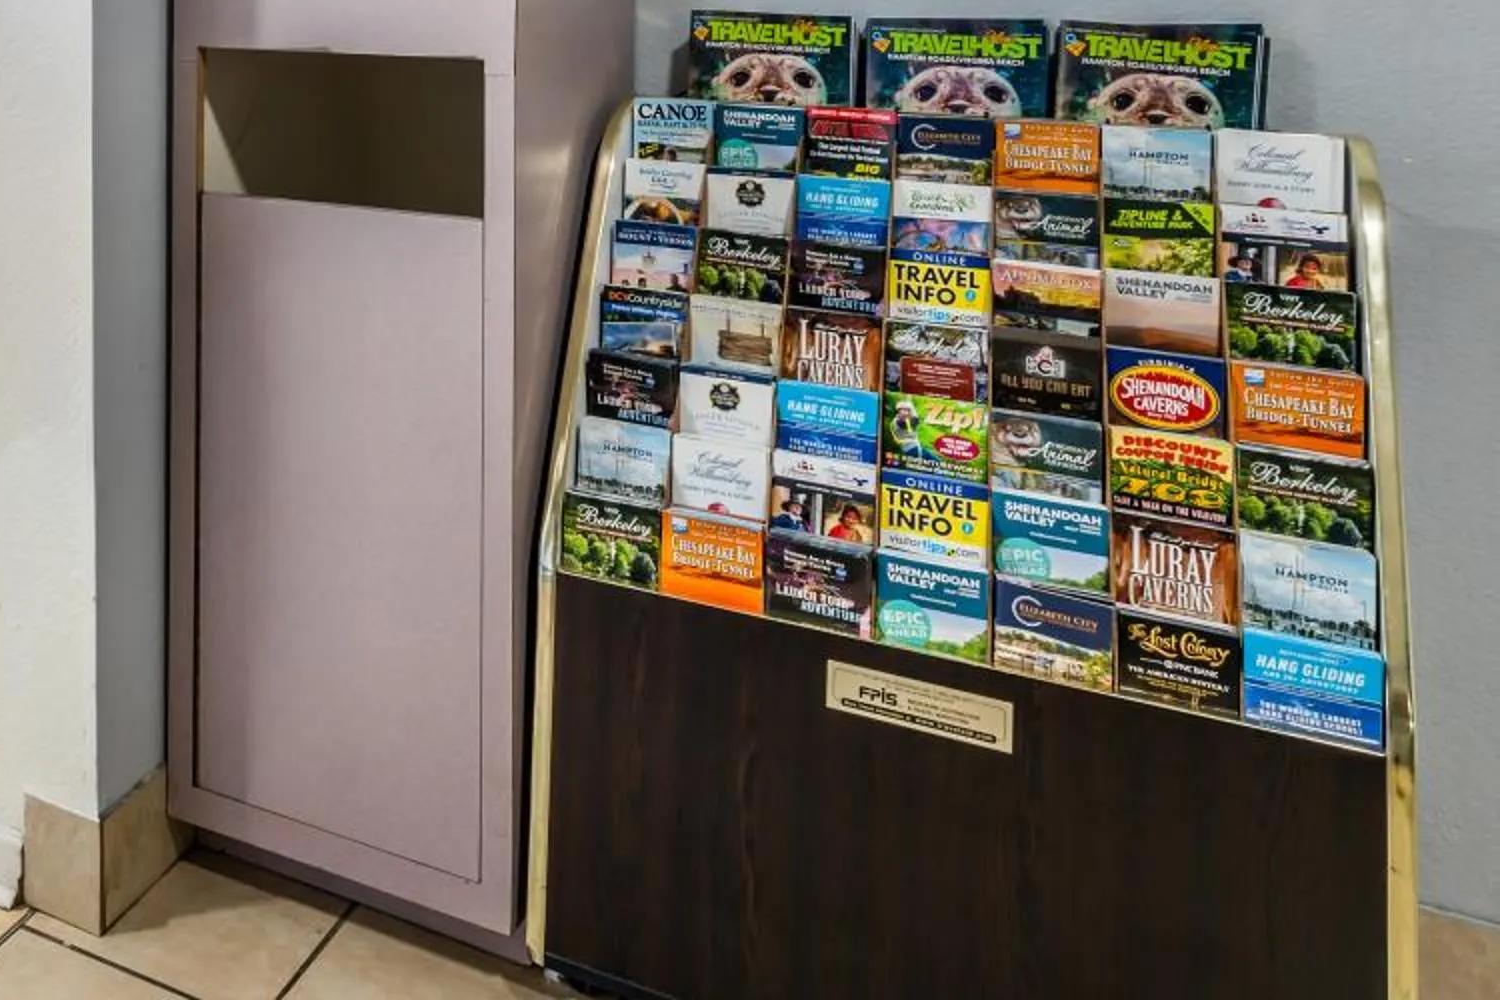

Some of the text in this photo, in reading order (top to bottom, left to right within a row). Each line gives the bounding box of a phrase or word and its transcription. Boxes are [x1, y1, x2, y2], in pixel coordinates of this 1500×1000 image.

[707, 18, 847, 48] TRAVELHOST
[889, 30, 1043, 60] TRAVELHOST
[1085, 34, 1253, 71] TRAVELHOST
[638, 103, 707, 121] CANOE
[723, 110, 796, 124] SHENANDOAH
[1129, 151, 1189, 161] HAMPTON
[1110, 219, 1194, 230] ADVENTURE PARK
[1119, 209, 1169, 222] ZIPLINE
[707, 236, 782, 267] Berkeley
[912, 251, 967, 266] ONLINE
[894, 263, 980, 289] TRAVEL
[1115, 276, 1213, 295] SHENANDOAH
[897, 283, 956, 306] INFO
[1116, 285, 1167, 300] VALLEY
[1243, 291, 1344, 330] Berkeley
[799, 319, 867, 367] LURAY
[797, 359, 865, 389] CAVERNS
[1021, 376, 1044, 392] YOU
[1120, 377, 1206, 411] SHENANDOAH
[1244, 387, 1356, 419] CHESAPEAKE BAY
[1133, 397, 1190, 418] CAVERNS
[1040, 440, 1098, 468] Animal
[1115, 446, 1230, 475] COUPON INSIDE
[1122, 435, 1224, 460] DISCOUNT
[905, 477, 964, 497] ONLINE
[1119, 475, 1227, 510] ZOO
[1176, 470, 1225, 491] Bridge
[1250, 461, 1358, 505] Berkeley
[886, 487, 979, 521] TRAVEL
[1004, 500, 1102, 526] SHENANDOAH
[576, 502, 653, 540] Berkeley
[888, 509, 953, 537] INFO
[1004, 509, 1058, 528] VALLEY
[1002, 548, 1044, 563] EPIC
[1129, 524, 1219, 587] LURAY
[886, 562, 981, 590] SHENANDOAH
[886, 571, 937, 591] VALLEY
[1275, 566, 1349, 587] HAMPTON
[1127, 573, 1214, 614] CAVERNS
[883, 610, 925, 626] EPIC
[1073, 615, 1099, 631] CITY
[1140, 625, 1180, 659] Lost
[1180, 631, 1231, 667] Colony
[1255, 652, 1366, 688] HANG GLIDING
